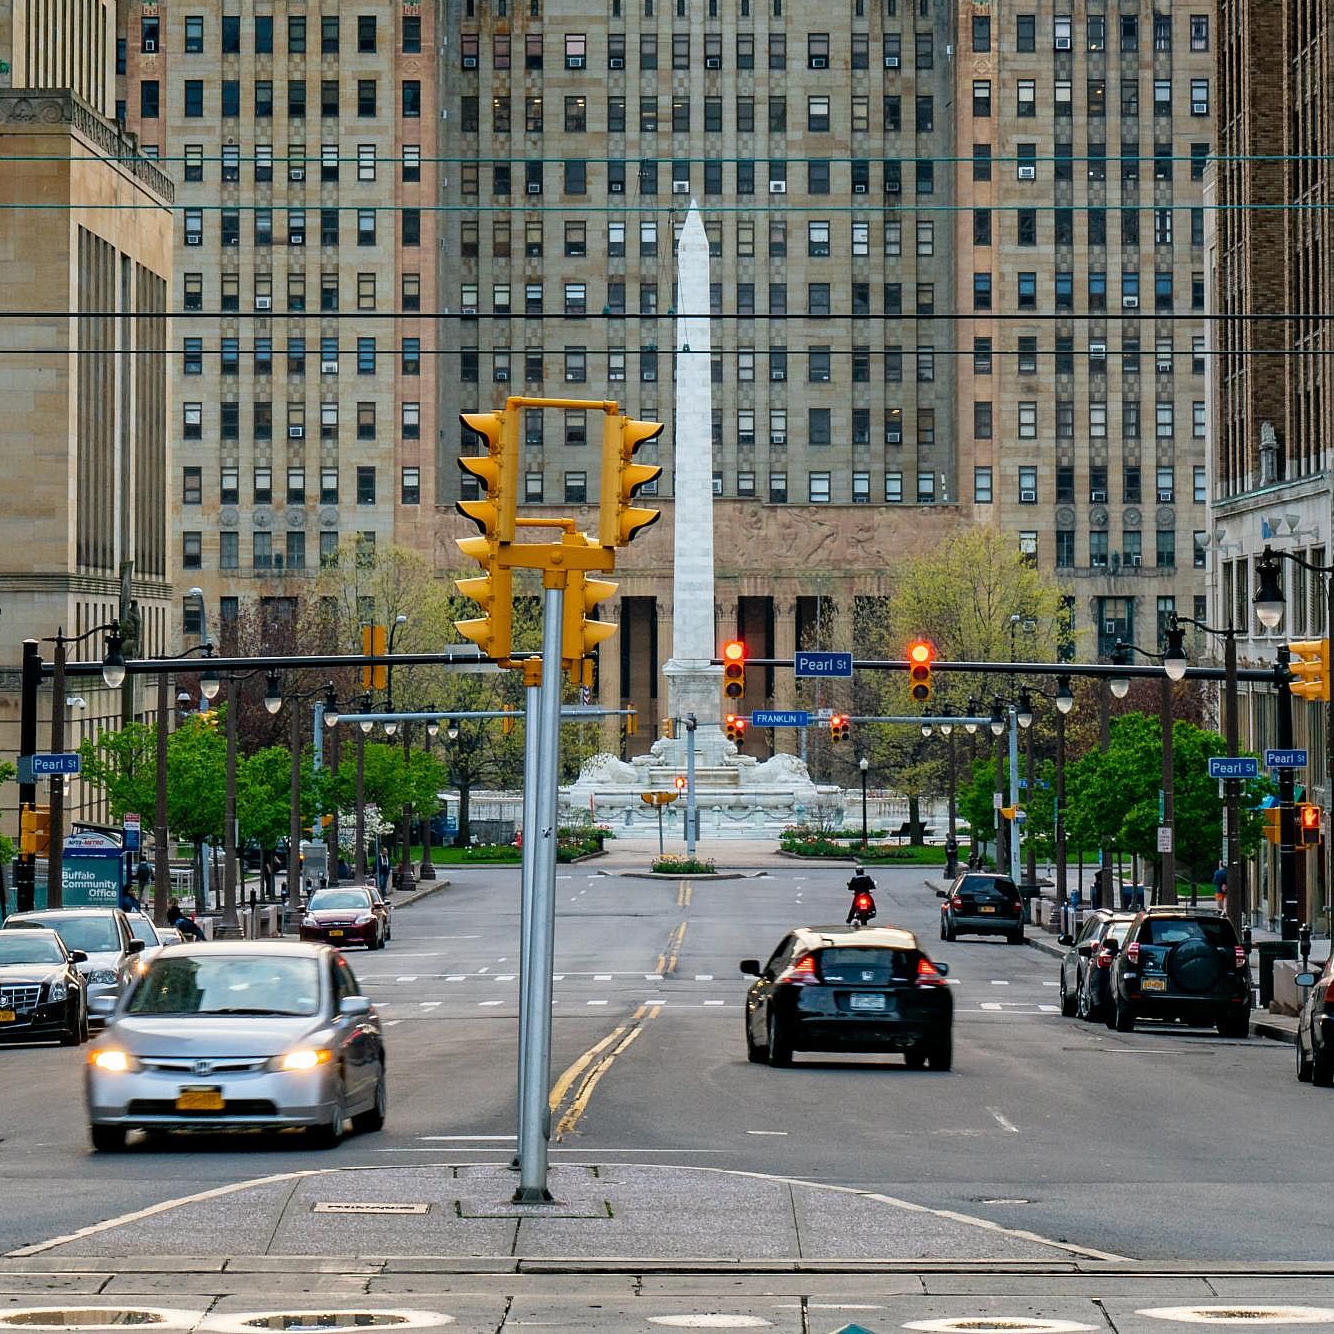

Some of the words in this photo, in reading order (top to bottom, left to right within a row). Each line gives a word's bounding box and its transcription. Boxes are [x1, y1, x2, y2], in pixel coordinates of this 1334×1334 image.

[800, 658, 833, 670] Pearl
[837, 660, 846, 669] St
[757, 715, 796, 723] FRANKLIN
[1268, 754, 1294, 763] Pearl
[1297, 754, 1305, 762] St
[34, 759, 63, 770] Pearl
[68, 760, 76, 768] St
[1212, 763, 1241, 773] Pearl
[1246, 764, 1254, 772] St
[62, 871, 95, 880] Buffalo
[62, 880, 116, 889] Community
[89, 889, 116, 897] Office
